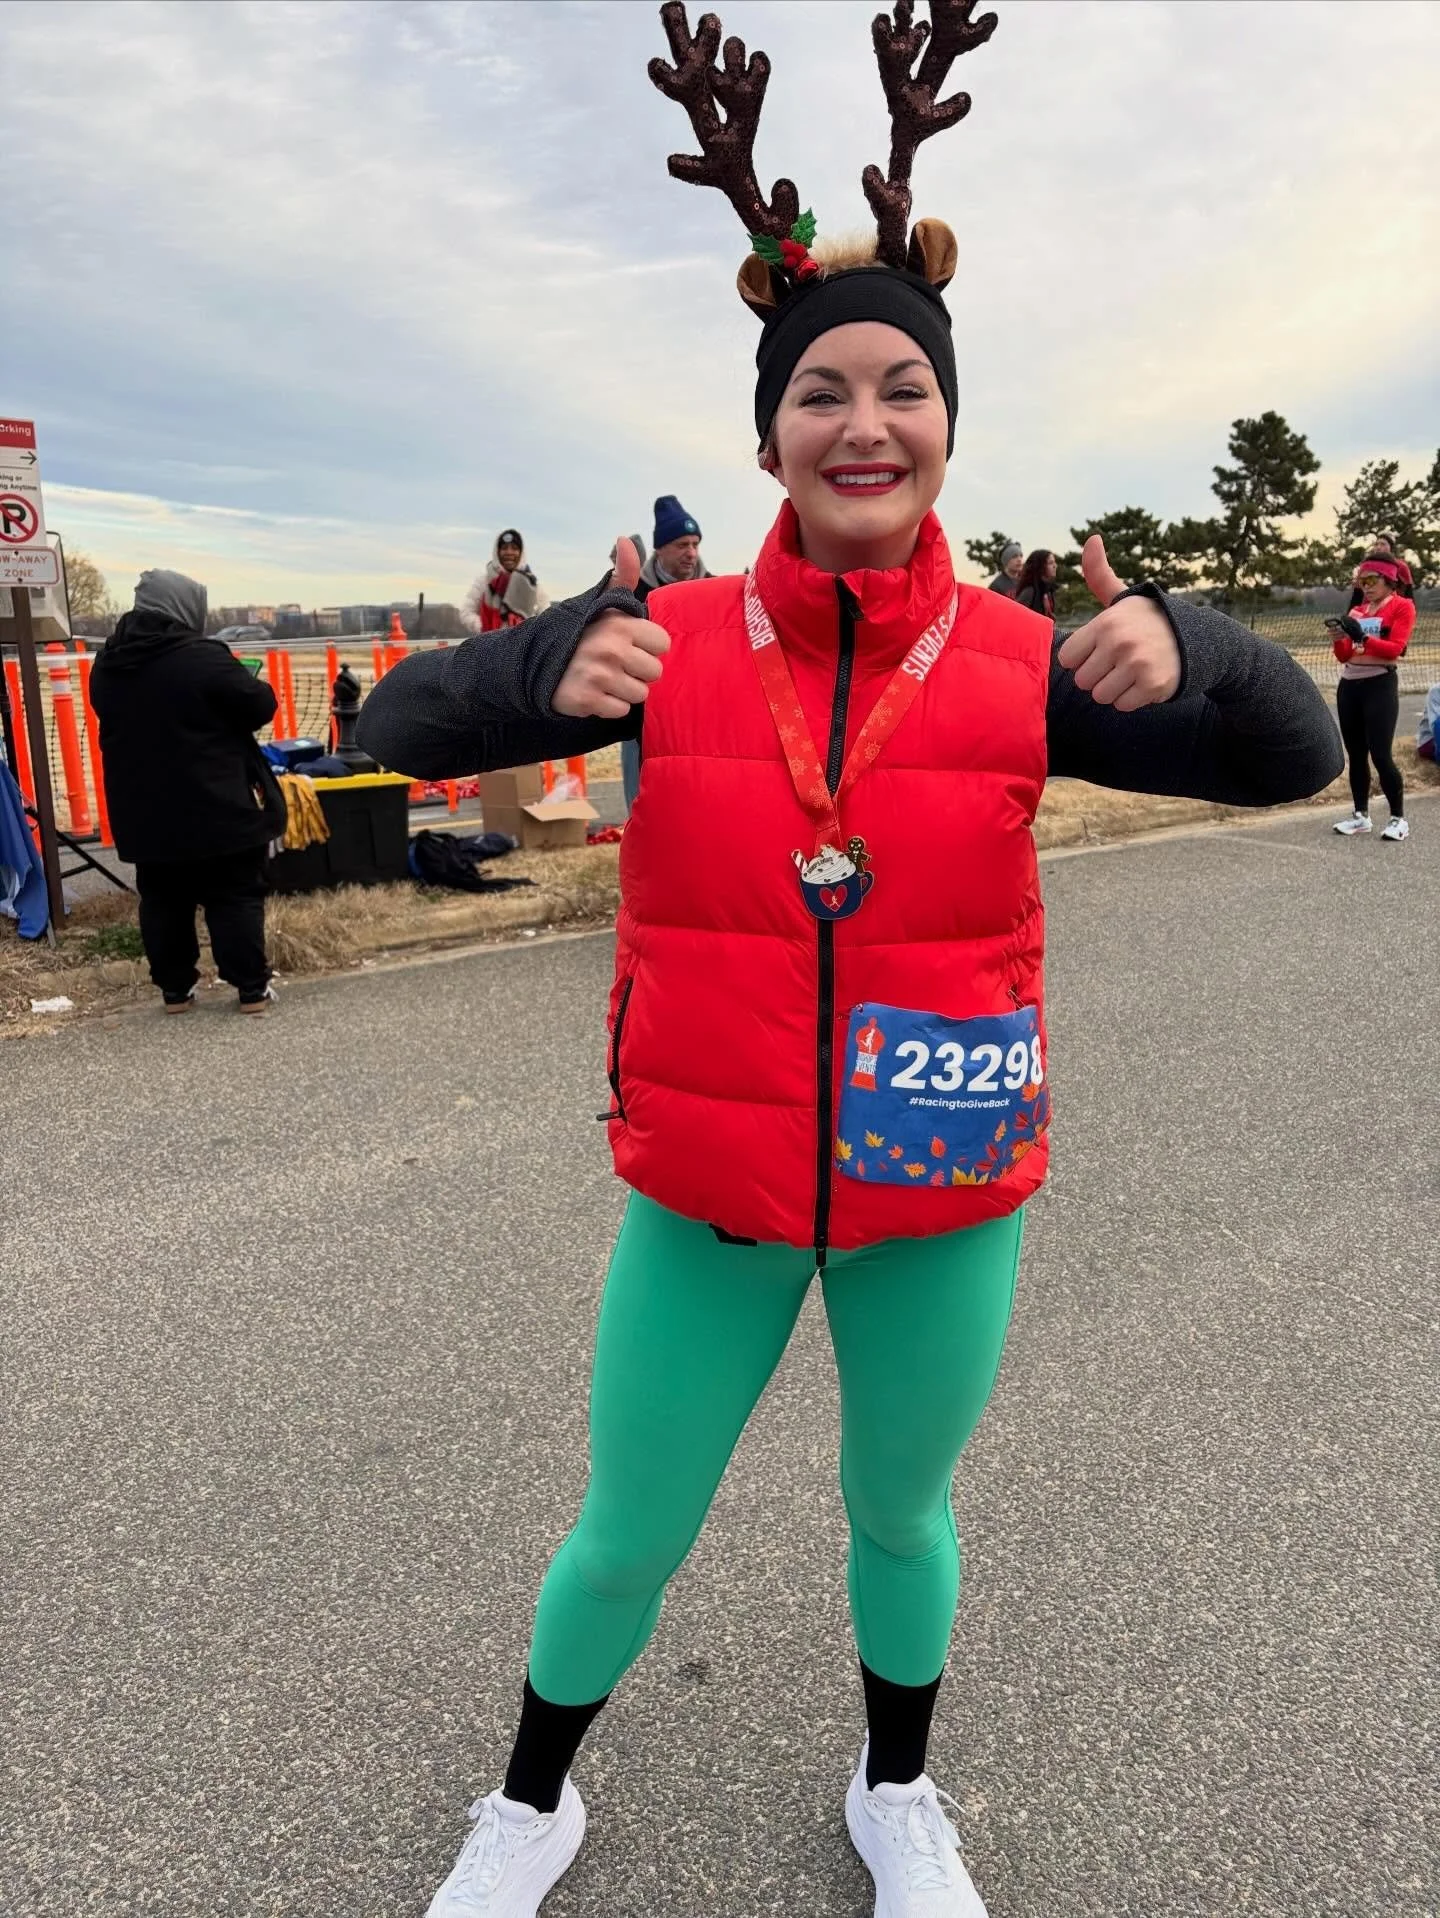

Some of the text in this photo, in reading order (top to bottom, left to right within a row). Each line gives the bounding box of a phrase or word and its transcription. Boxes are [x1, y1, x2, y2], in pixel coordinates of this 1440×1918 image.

[10, 483, 37, 491] Anytime
[0, 555, 47, 564] W-AWAY
[4, 569, 33, 577] ZONE
[902, 625, 945, 681] EVENTS
[890, 1034, 1044, 1093] 23298
[909, 1097, 1010, 1110] #RacingtoGiveBack
